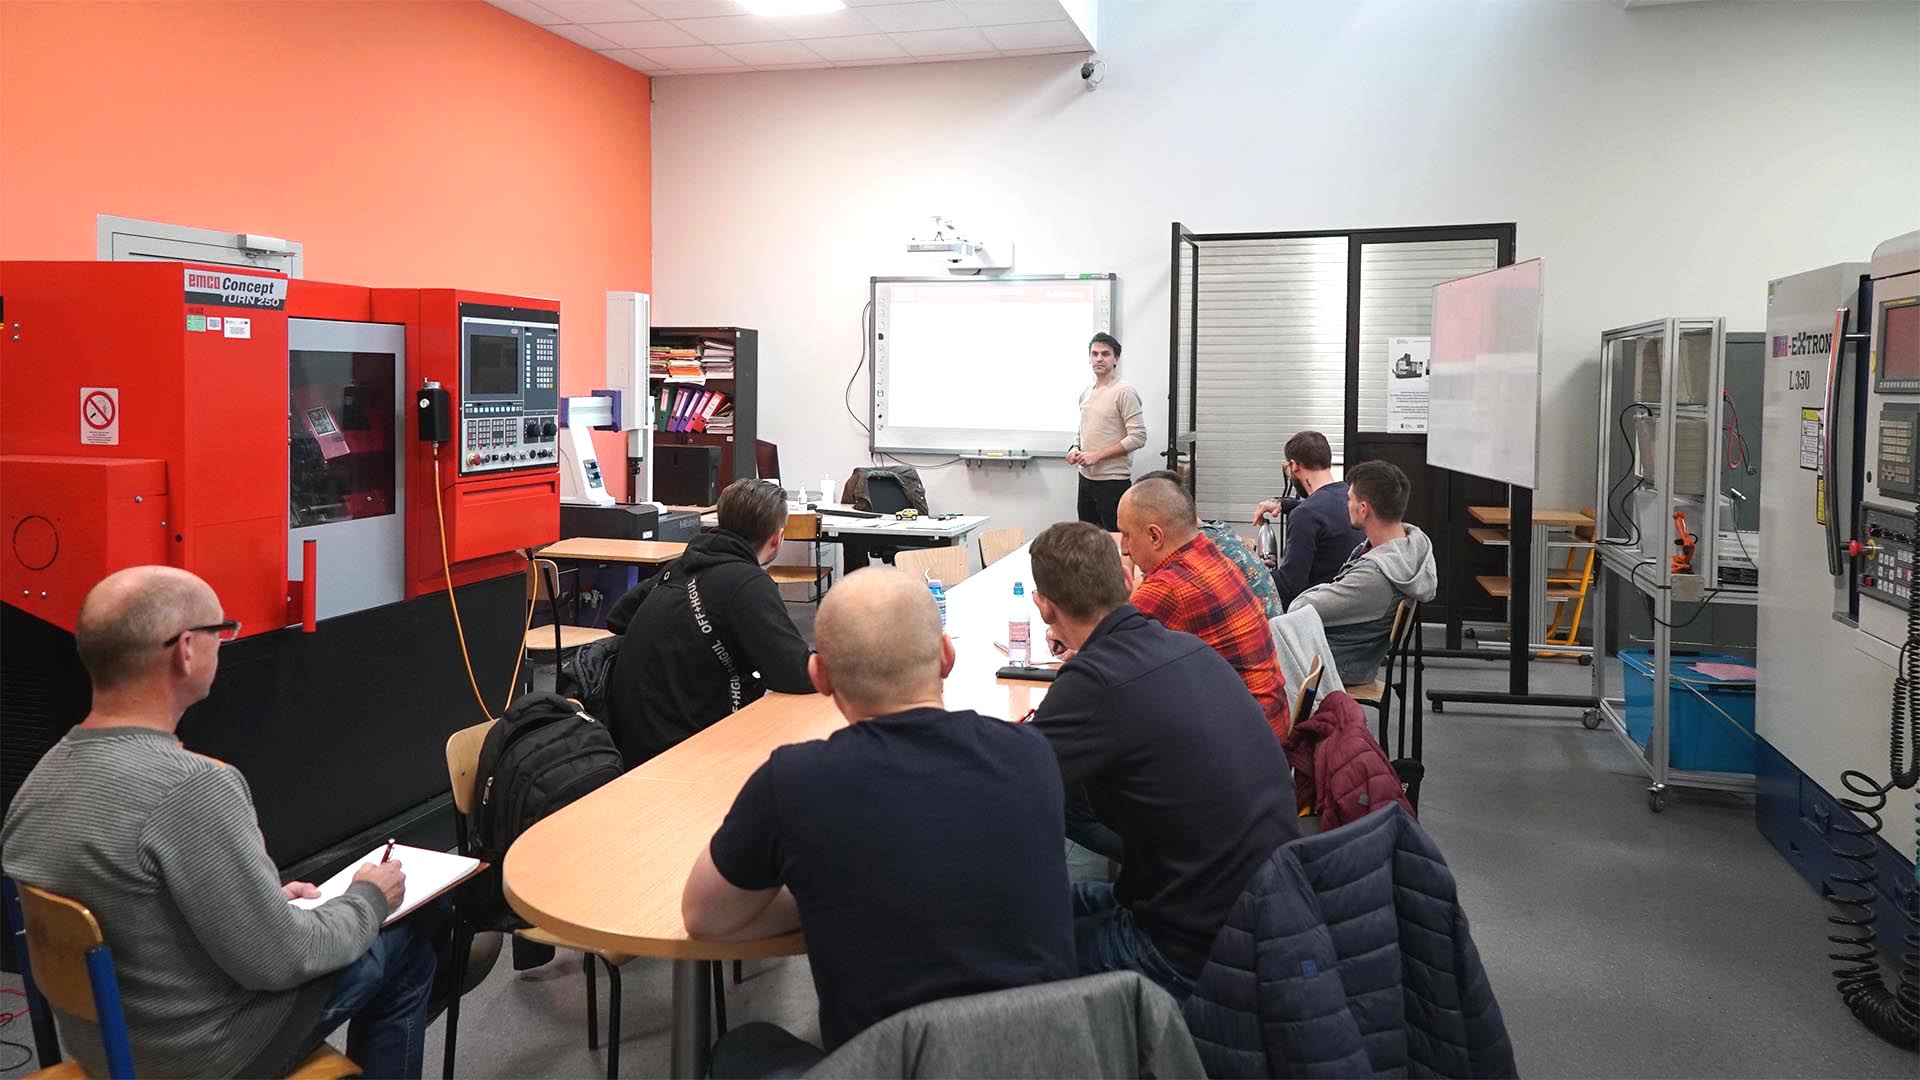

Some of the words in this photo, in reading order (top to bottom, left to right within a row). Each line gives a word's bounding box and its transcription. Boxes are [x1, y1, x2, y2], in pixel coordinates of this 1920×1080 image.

[189, 274, 220, 289] emco
[222, 278, 274, 296] Concept
[222, 294, 256, 305] TURN
[257, 298, 280, 307] 250
